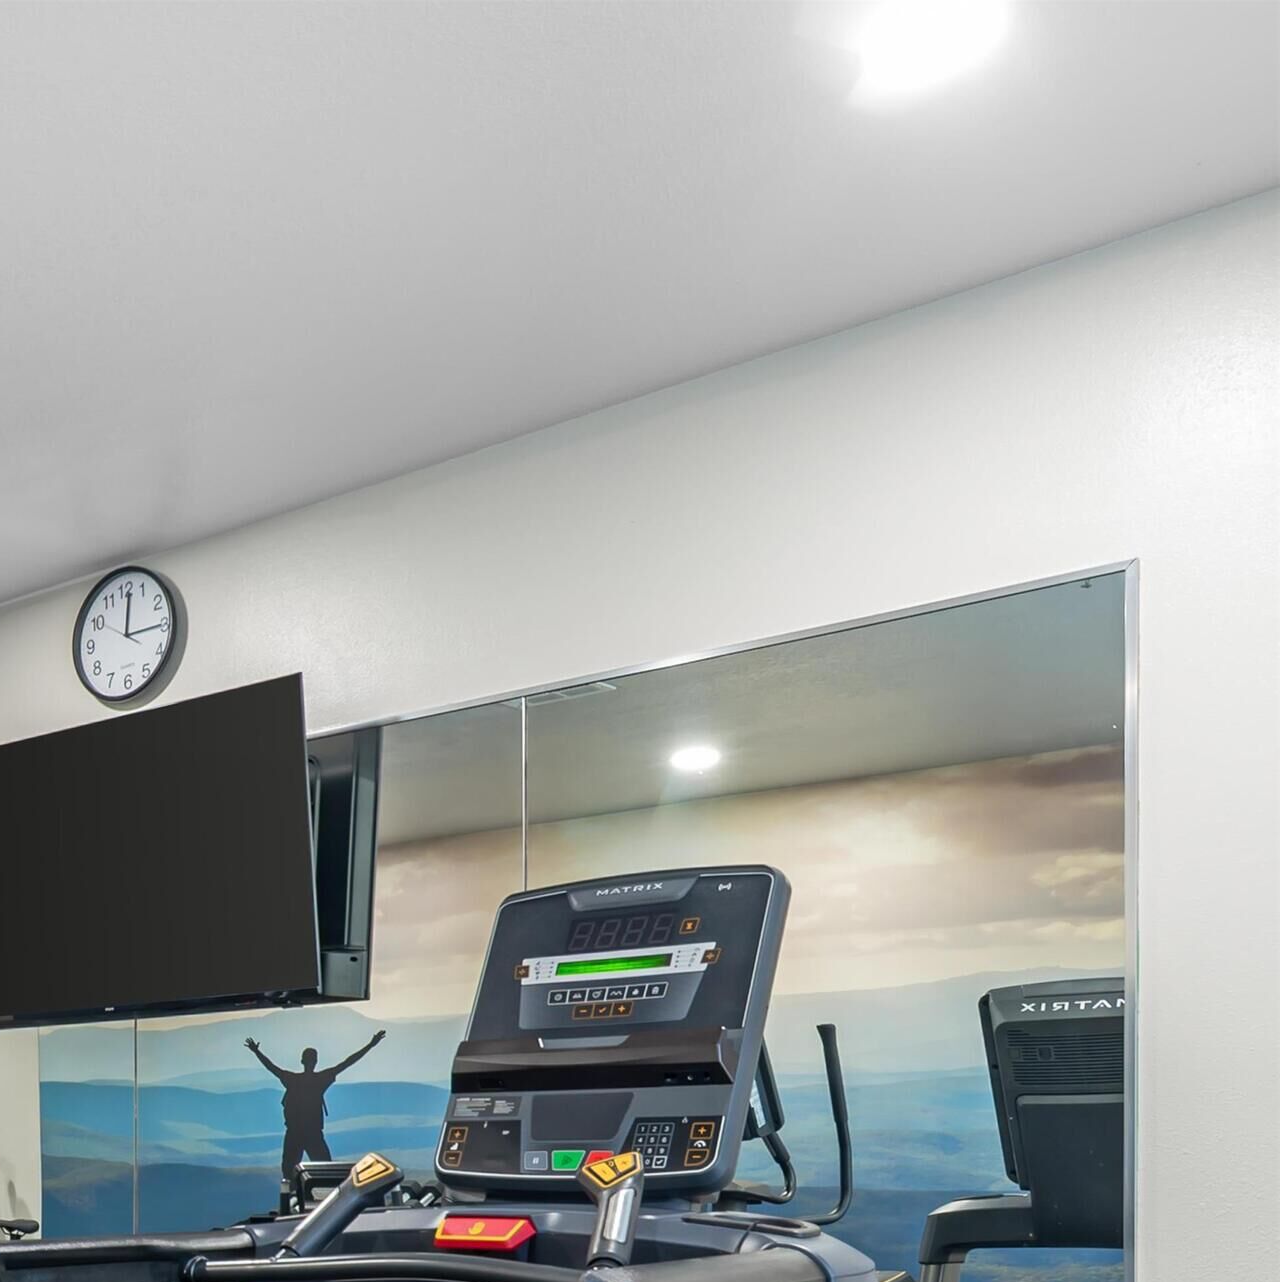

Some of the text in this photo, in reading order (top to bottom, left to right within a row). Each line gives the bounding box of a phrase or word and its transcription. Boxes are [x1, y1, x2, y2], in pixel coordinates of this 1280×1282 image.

[118, 581, 134, 600] 12
[139, 582, 145, 597] 1
[102, 593, 115, 610] 11
[153, 594, 162, 610] 2
[91, 614, 105, 632] 10
[160, 616, 169, 632] 3
[86, 639, 95, 655] 9
[155, 642, 165, 657] 4
[93, 660, 102, 676] 8
[142, 663, 151, 679] 5
[106, 672, 115, 689] 7
[123, 674, 133, 690] 6
[595, 882, 664, 896] MATRIX
